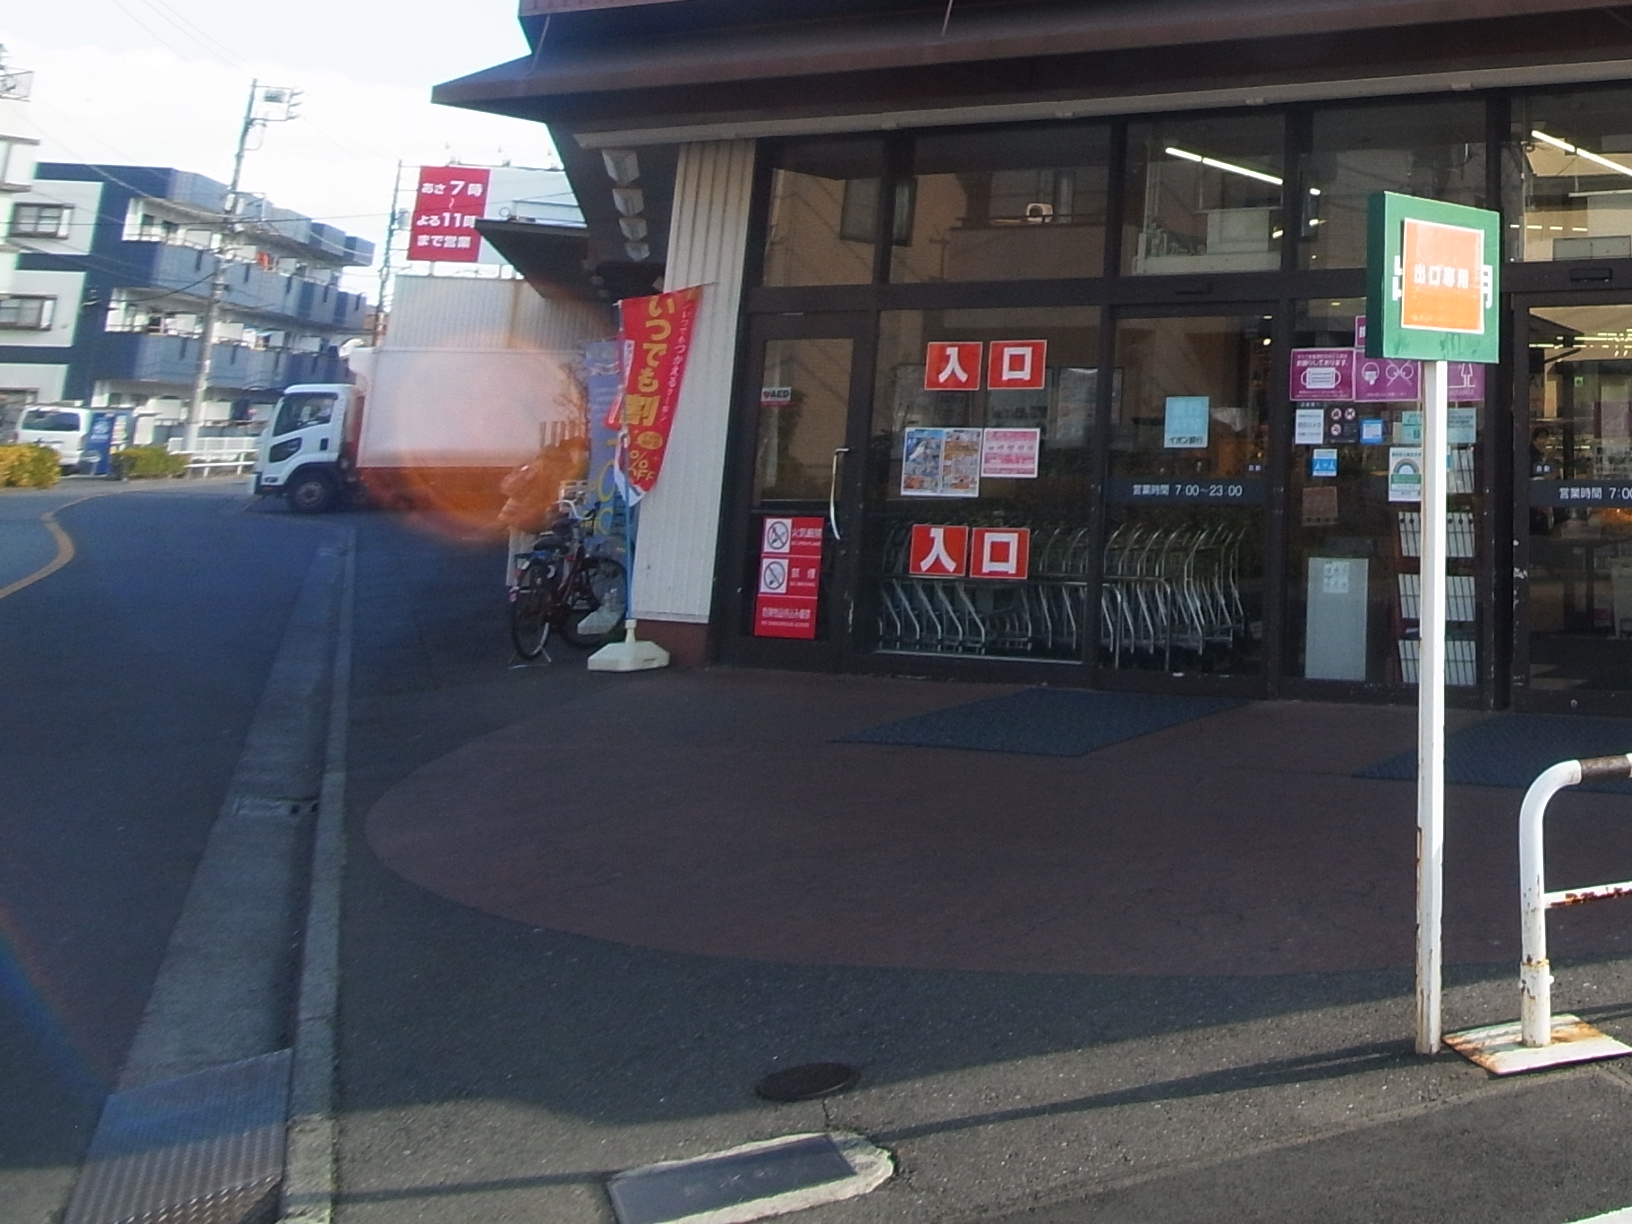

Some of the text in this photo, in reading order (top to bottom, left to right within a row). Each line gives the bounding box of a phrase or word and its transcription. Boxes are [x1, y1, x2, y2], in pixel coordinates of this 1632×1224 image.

[417, 234, 471, 249] まで営業
[1413, 262, 1469, 290] 出口専用
[938, 346, 1033, 383] 入口
[1133, 484, 1170, 496] 営業時間
[1559, 487, 1602, 499] 営業時間
[919, 527, 1019, 574] 入口
